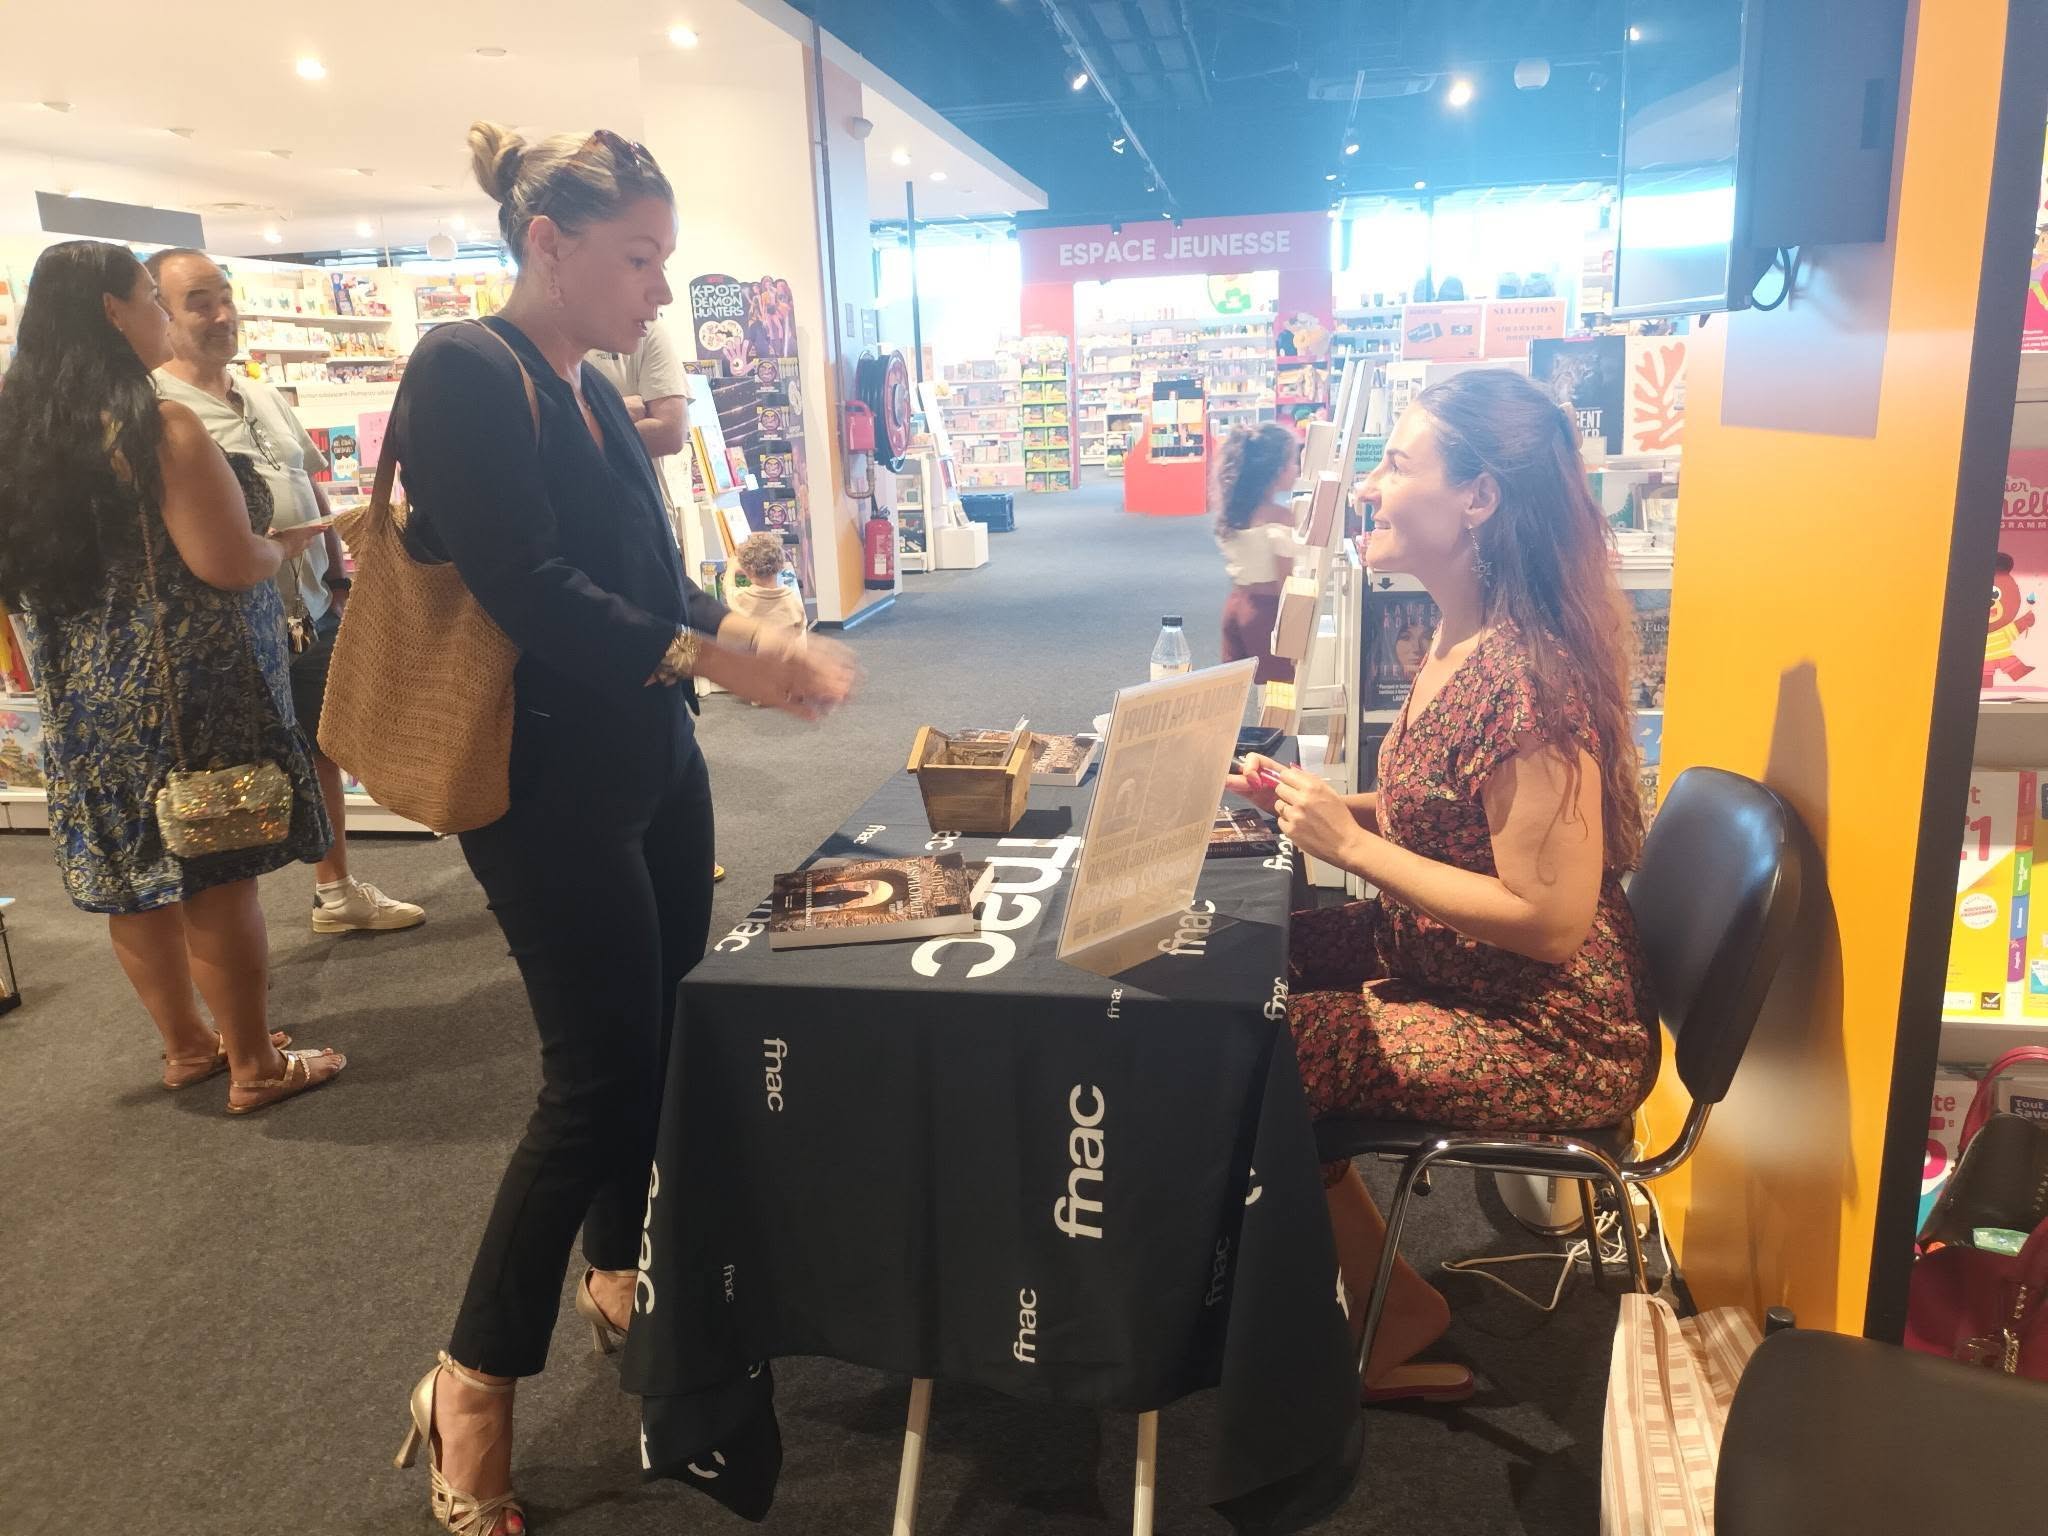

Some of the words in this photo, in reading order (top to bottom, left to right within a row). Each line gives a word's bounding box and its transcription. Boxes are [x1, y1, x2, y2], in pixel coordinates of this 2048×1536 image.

[1059, 238, 1156, 266] ESPACE
[1163, 230, 1291, 260] JEUNESSE
[691, 284, 741, 298] K-POP
[693, 294, 743, 308] DEMON
[694, 306, 745, 319] HUNTERS
[1158, 899, 1216, 955] fnac
[763, 1037, 788, 1112] fnac
[2016, 1099, 2044, 1109] Tout
[1053, 1083, 1106, 1239] fnac
[723, 1264, 736, 1304] fnac
[1013, 1288, 1038, 1364] fnac
